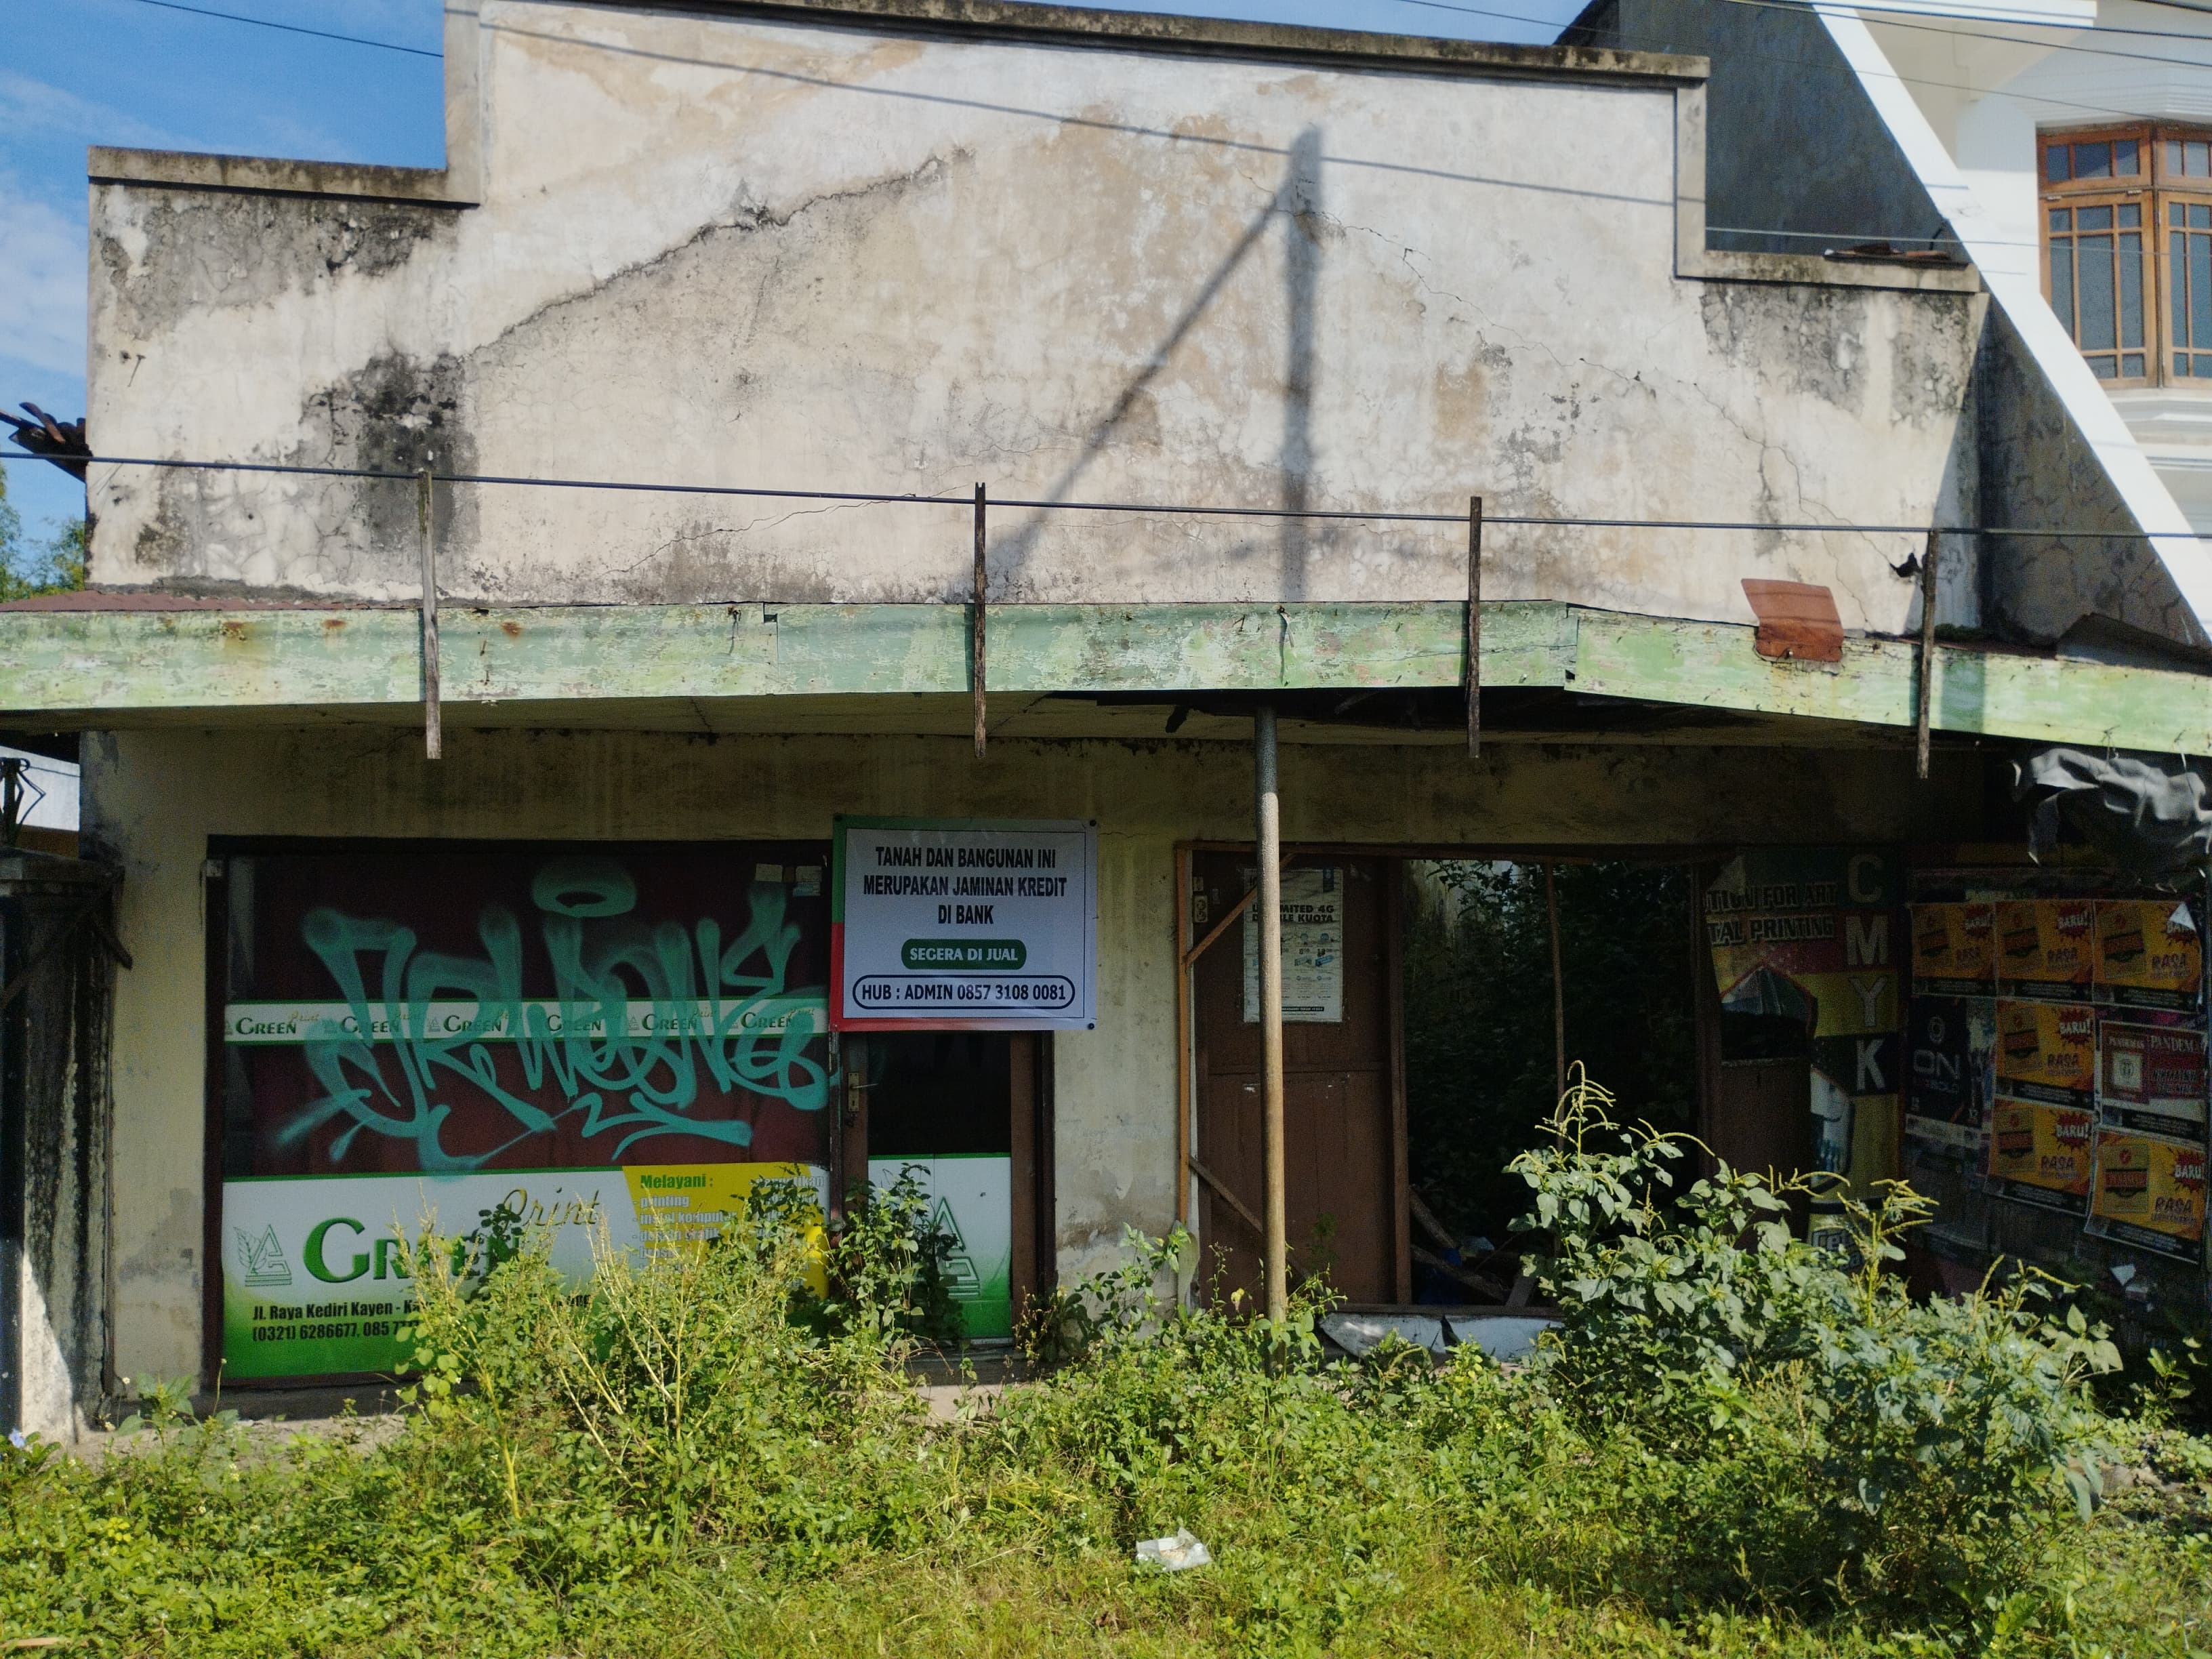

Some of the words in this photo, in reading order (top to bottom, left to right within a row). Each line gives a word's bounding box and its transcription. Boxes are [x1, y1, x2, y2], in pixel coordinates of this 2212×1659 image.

[876, 846, 922, 867] TANAH
[926, 847, 954, 867] DAN
[958, 848, 1033, 869] BANGUNAN
[1038, 848, 1056, 869] INI
[863, 875, 948, 897] MERUPAKAN
[952, 876, 1014, 897] JAMINAN
[1018, 877, 1067, 897] KREDIT
[1762, 884, 1799, 909] FOR
[1805, 882, 1838, 907] ART
[938, 905, 951, 924] DI
[956, 905, 994, 924] BANK
[1252, 904, 1313, 914] UMITED
[1318, 905, 1334, 914] 4G
[1252, 914, 1294, 922] DLE
[1298, 914, 1334, 922] KUOTA
[1748, 915, 1835, 942] PRINTING
[909, 947, 963, 961] SEGERA
[967, 948, 983, 961] DI
[987, 948, 1019, 961] JUAL
[862, 985, 892, 1000] HUB
[905, 985, 953, 1000] ADMIN
[958, 985, 991, 1000] 0857
[995, 985, 1029, 1000] 3108
[1033, 985, 1066, 1001] 0081
[235, 1017, 296, 1034] GREEN
[341, 1016, 401, 1034] GEEN
[2059, 1018, 2092, 1036] BARU!
[1912, 1048, 1961, 1080] ON
[2055, 1122, 2089, 1140] BARU!
[2041, 1155, 2075, 1170] RASA
[640, 1174, 706, 1189] Melayani
[640, 1195, 690, 1208] pinting
[2154, 1196, 2193, 1214] RASA
[269, 1305, 304, 1320] Raya
[306, 1301, 348, 1317] Kediri
[350, 1300, 393, 1317] Kayen
[253, 1326, 296, 1341] (0321)
[363, 1321, 390, 1336] 085
